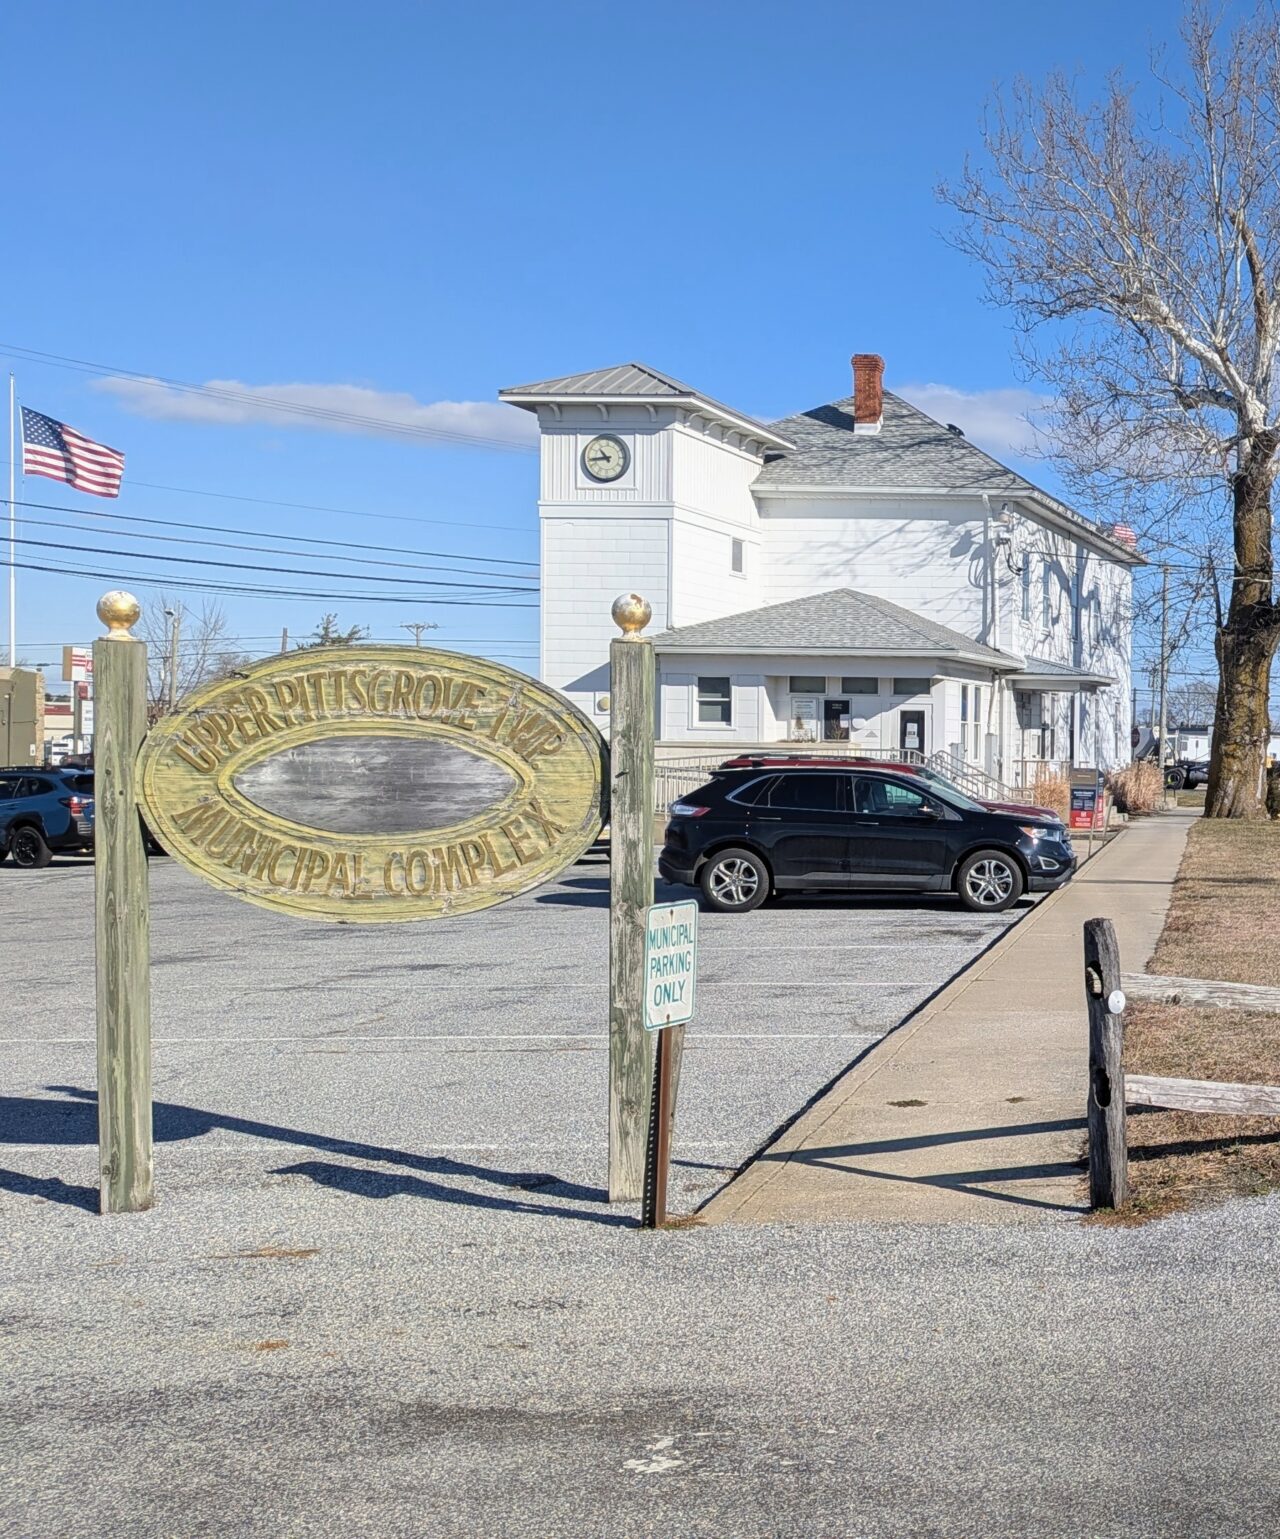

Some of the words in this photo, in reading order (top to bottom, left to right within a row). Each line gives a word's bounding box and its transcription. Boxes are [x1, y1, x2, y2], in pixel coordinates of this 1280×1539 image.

[174, 686, 285, 773] UPPER
[273, 669, 488, 730] PITTSGROVE
[488, 692, 568, 770] TWP.
[171, 800, 374, 899] MUNICIPAL
[383, 796, 569, 897] COMPLEX
[649, 922, 694, 950] MUNICIPAL
[650, 951, 691, 979] PARKING
[653, 980, 686, 1007] ONLY
